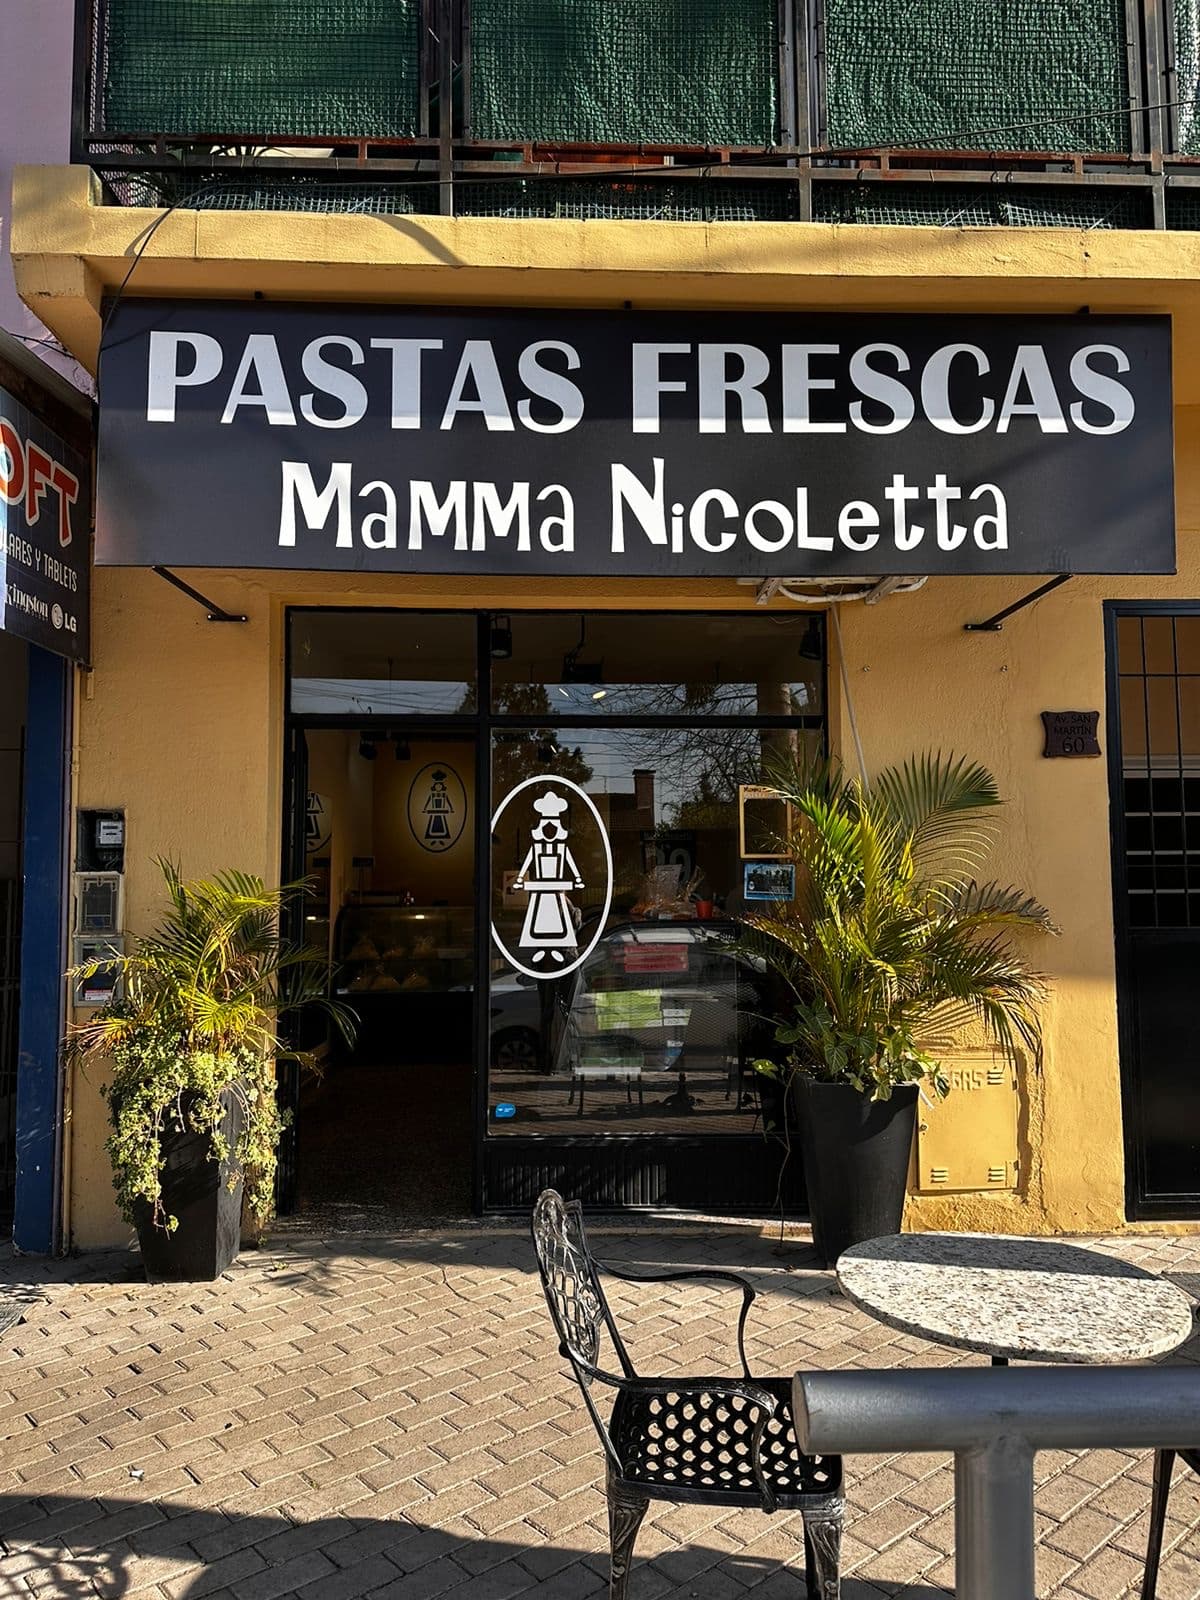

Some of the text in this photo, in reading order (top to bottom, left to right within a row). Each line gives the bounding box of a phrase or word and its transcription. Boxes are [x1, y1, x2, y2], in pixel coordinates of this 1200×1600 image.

[147, 330, 1135, 435] PASTAS FRESCAS
[34, 547, 41, 572] Y
[43, 552, 78, 593] TABLETS
[64, 612, 77, 633] LG
[1062, 736, 1085, 753] 60
